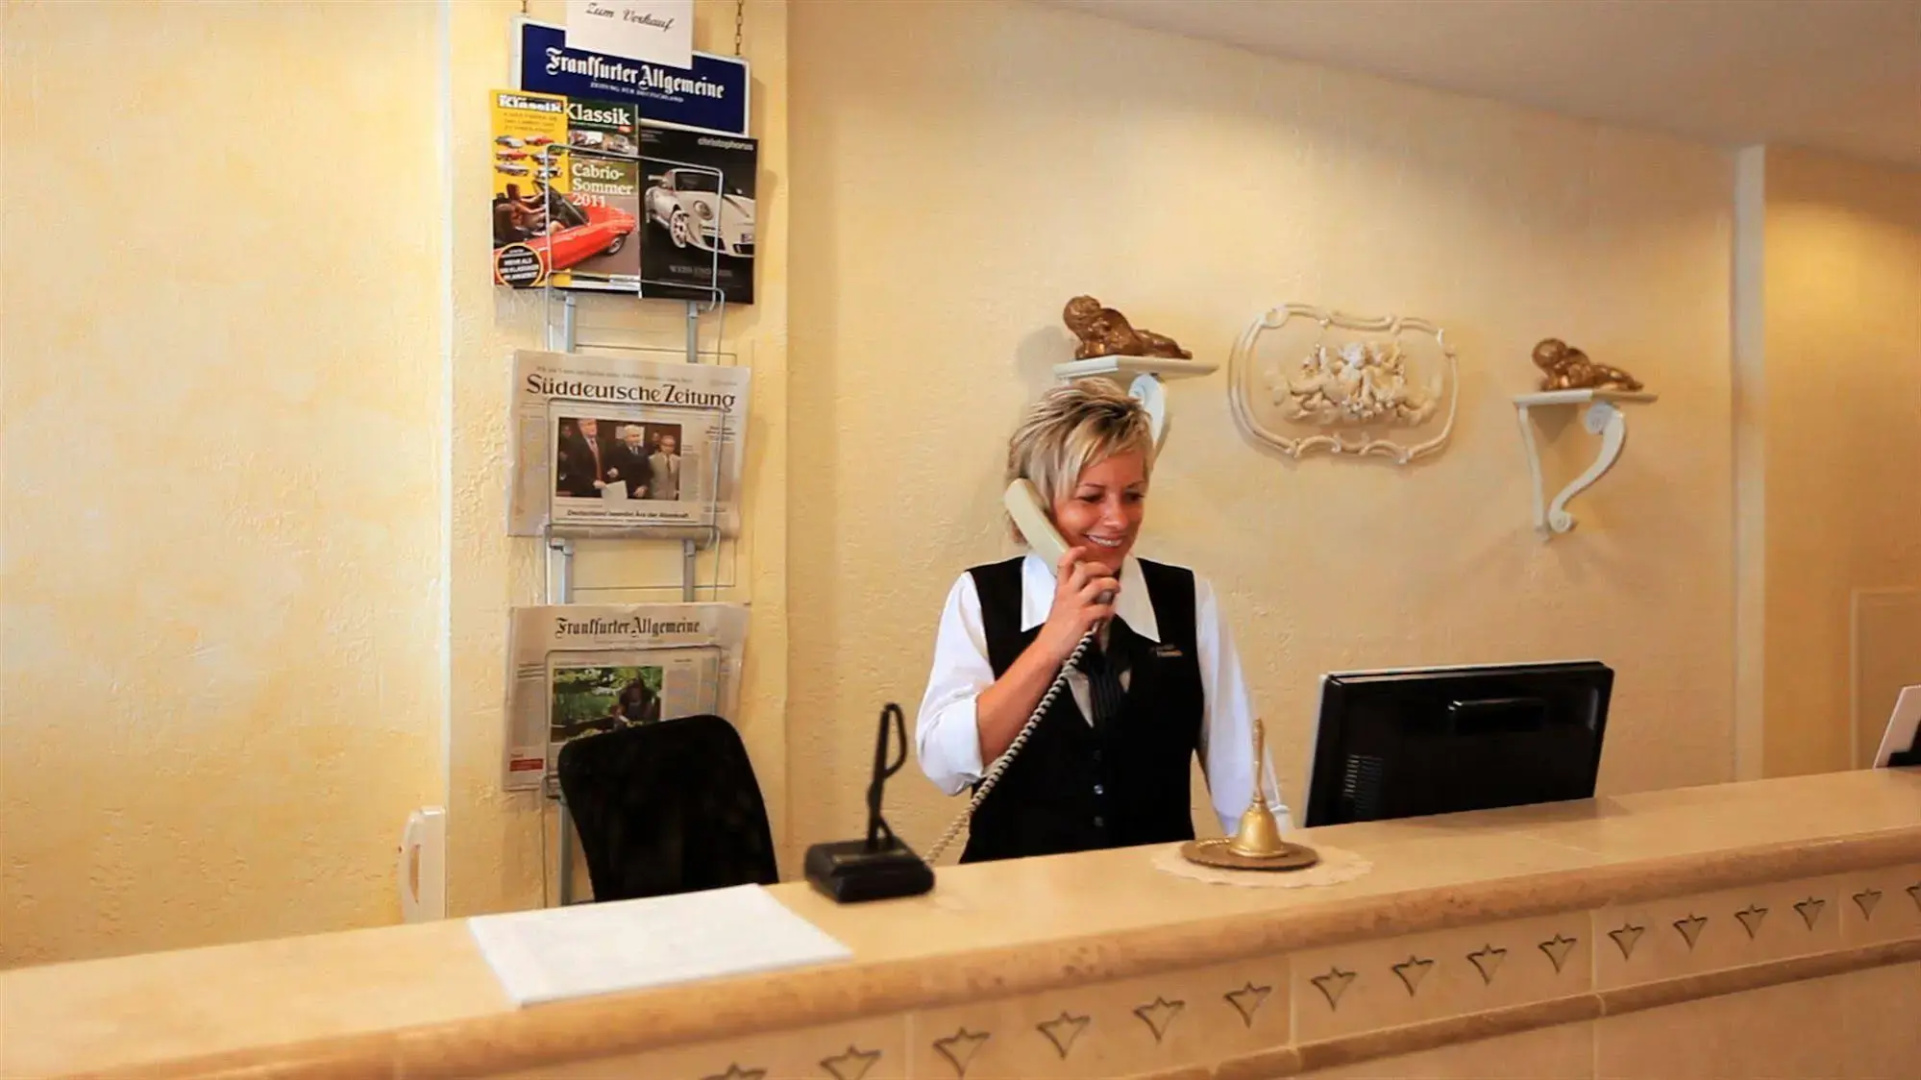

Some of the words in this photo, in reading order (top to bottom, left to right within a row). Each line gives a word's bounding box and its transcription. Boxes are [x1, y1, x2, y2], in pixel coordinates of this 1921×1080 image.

[585, 2, 615, 19] Zum
[622, 6, 676, 32] Verkauf
[546, 47, 639, 84] Frankfurter
[638, 65, 725, 99] Allgemeine
[564, 103, 631, 125] Klassik
[572, 163, 624, 180] Cabrio-
[573, 178, 634, 195] Sommer
[572, 192, 606, 208] 2011
[526, 373, 660, 403] Süddeutsche
[661, 384, 736, 413] Zeitung
[555, 617, 630, 639] Frankfurter
[631, 616, 700, 638] Allgemeine
